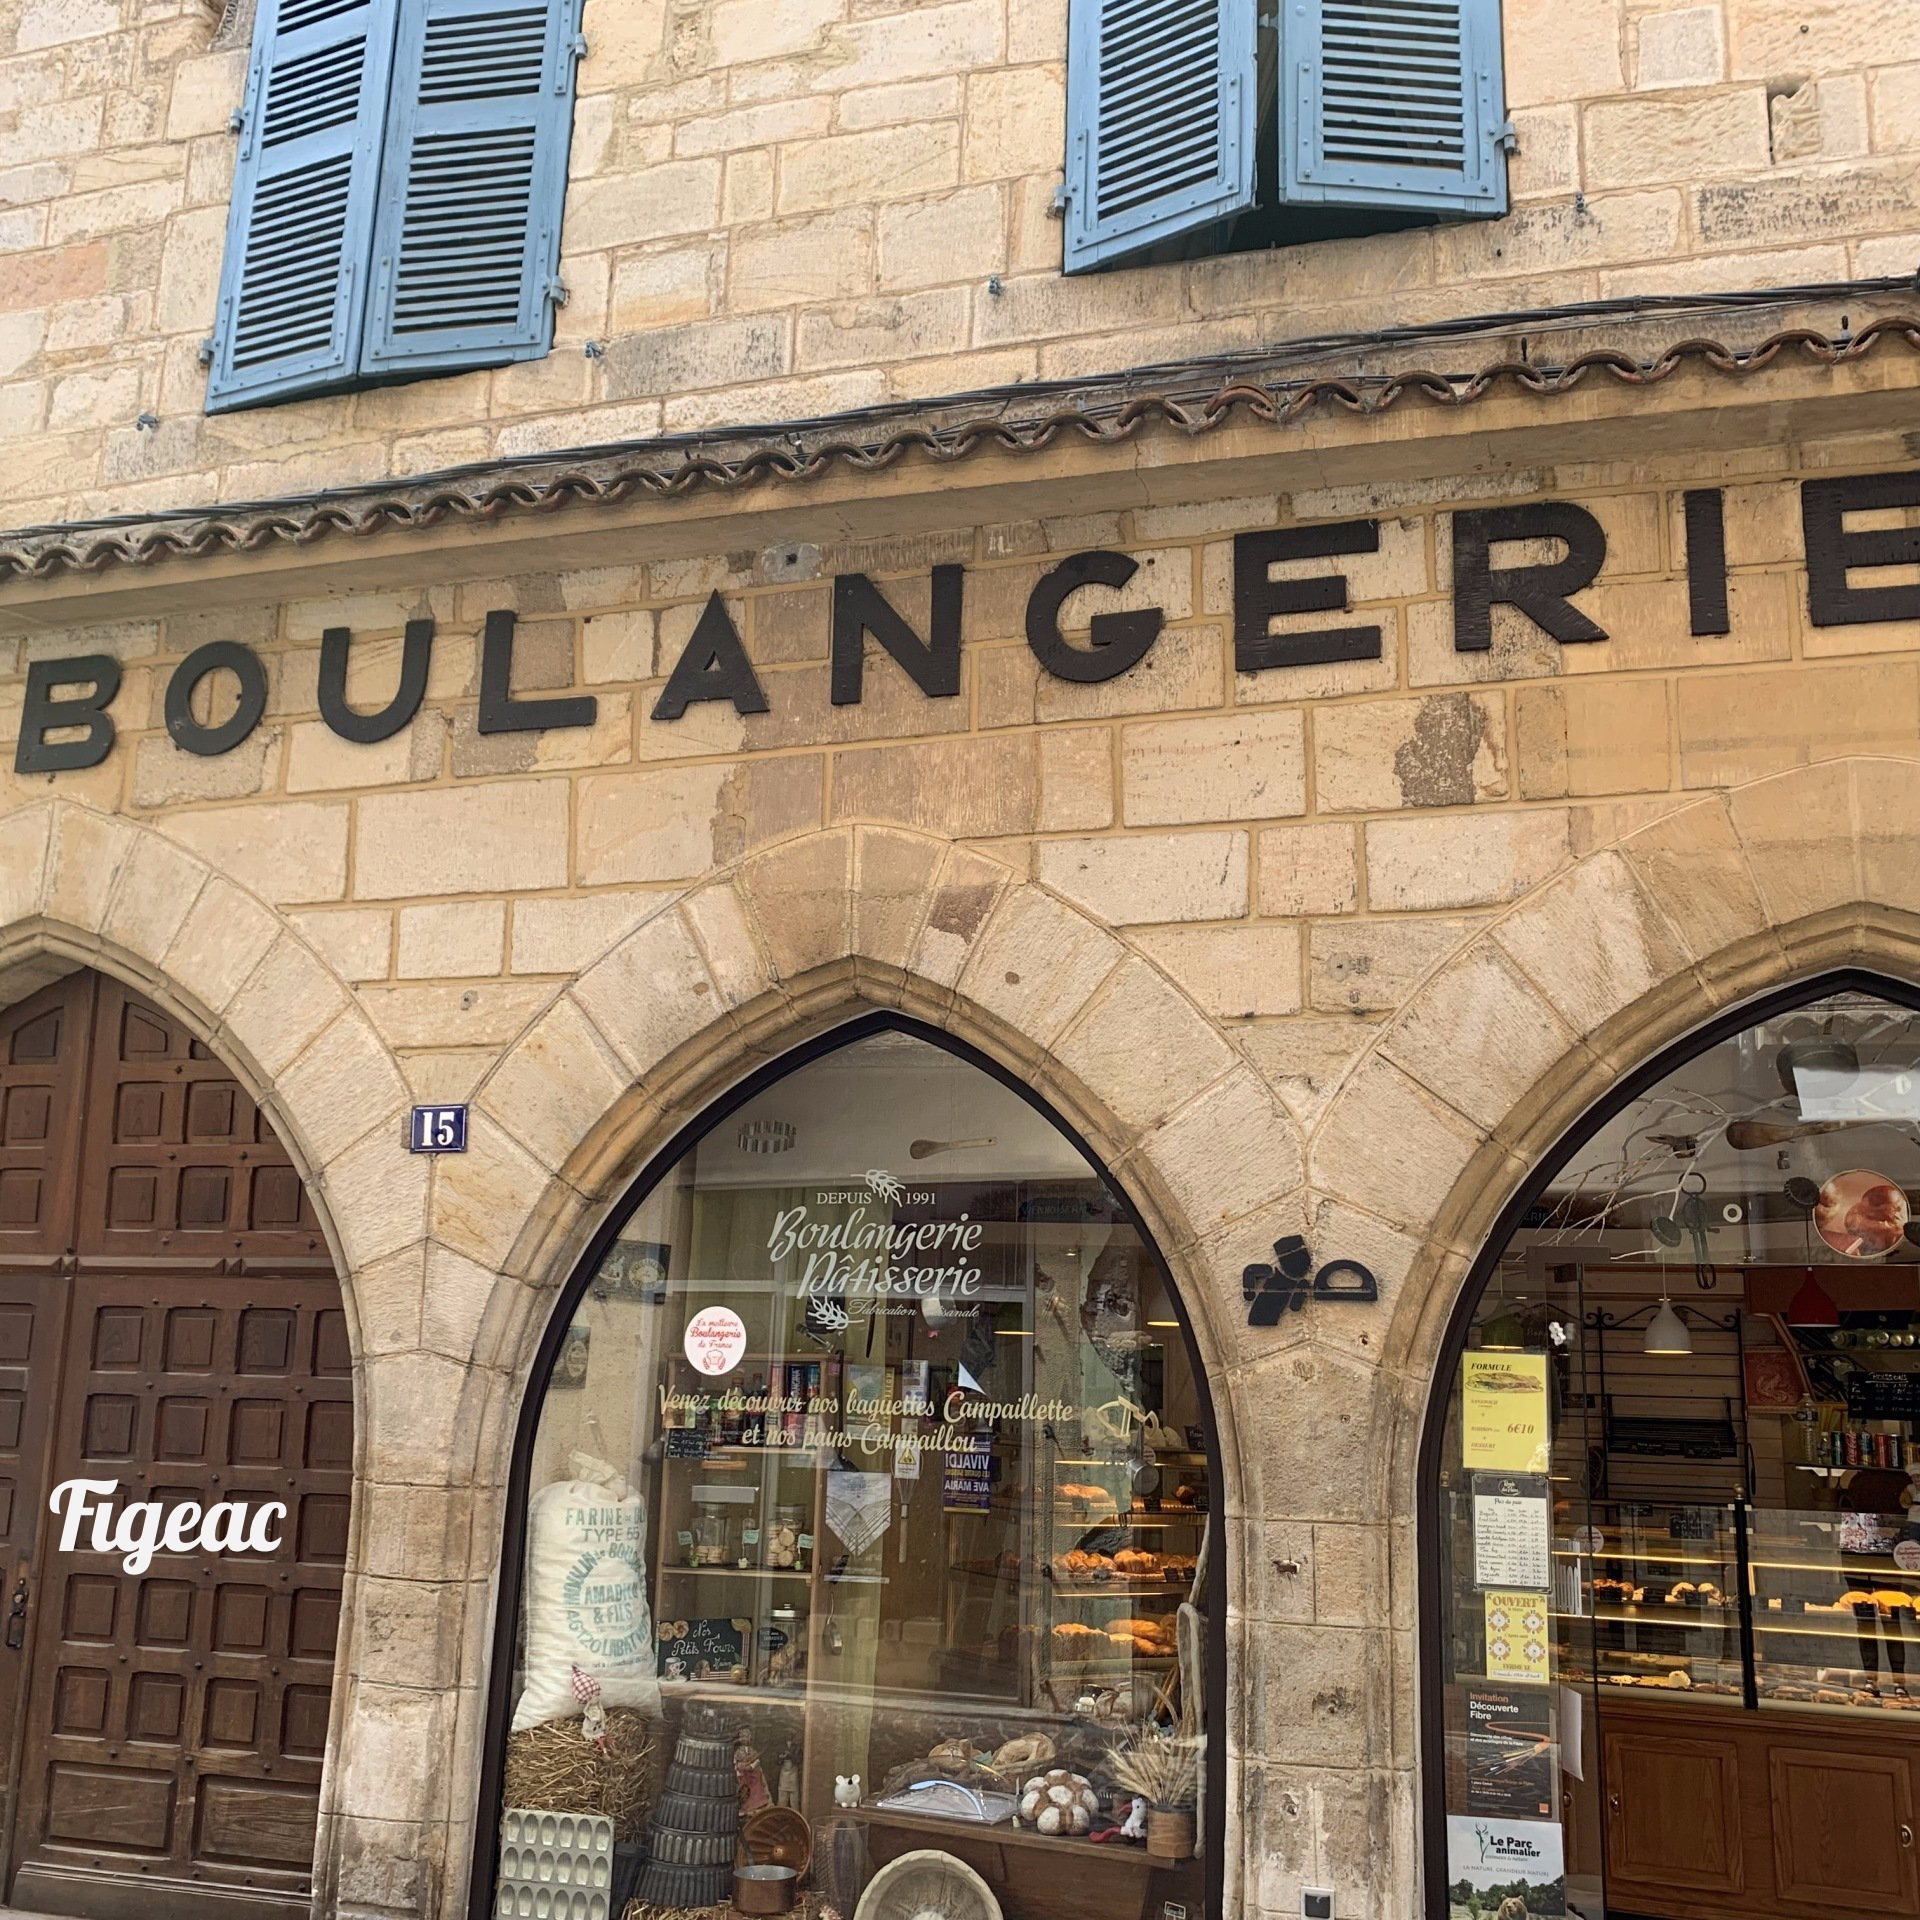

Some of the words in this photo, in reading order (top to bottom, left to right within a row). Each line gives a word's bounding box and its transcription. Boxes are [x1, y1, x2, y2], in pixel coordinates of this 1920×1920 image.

[14, 471, 1920, 774] BOULANGERIE
[421, 1111, 455, 1146] 15
[816, 1192, 872, 1205] DEPUIS
[906, 1192, 936, 1205] 1991
[767, 1206, 983, 1263] Boulangerie
[796, 1251, 982, 1300] Pâtisserie
[848, 1299, 918, 1316] Fabrication
[690, 1327, 742, 1341] Boulangerie
[1471, 1362, 1513, 1372] FORMULE
[658, 1384, 711, 1415] Venez
[718, 1387, 806, 1413] découvrir
[808, 1395, 839, 1413] nos
[846, 1388, 935, 1422] baguettes
[943, 1391, 1073, 1424] Campaillette
[1507, 1423, 1535, 1434] 6€10
[741, 1423, 760, 1445] et
[766, 1429, 796, 1446] nos
[802, 1426, 853, 1450] pains
[860, 1422, 978, 1455] Campaillou
[565, 1507, 622, 1526] FARINE
[581, 1527, 624, 1543] TYPE
[627, 1526, 641, 1541] 55
[1492, 1595, 1539, 1608] OUVERT
[593, 1606, 605, 1624] &
[607, 1602, 633, 1623] FILS
[671, 1640, 699, 1656] Petits
[704, 1634, 736, 1653] Fours
[1470, 1692, 1509, 1703] Invitation
[1470, 1701, 1519, 1713] Découverte
[1470, 1710, 1492, 1720] Fibre
[1490, 1835, 1504, 1847] Le
[1506, 1836, 1533, 1849] Parc
[1495, 1846, 1541, 1857] animalier
